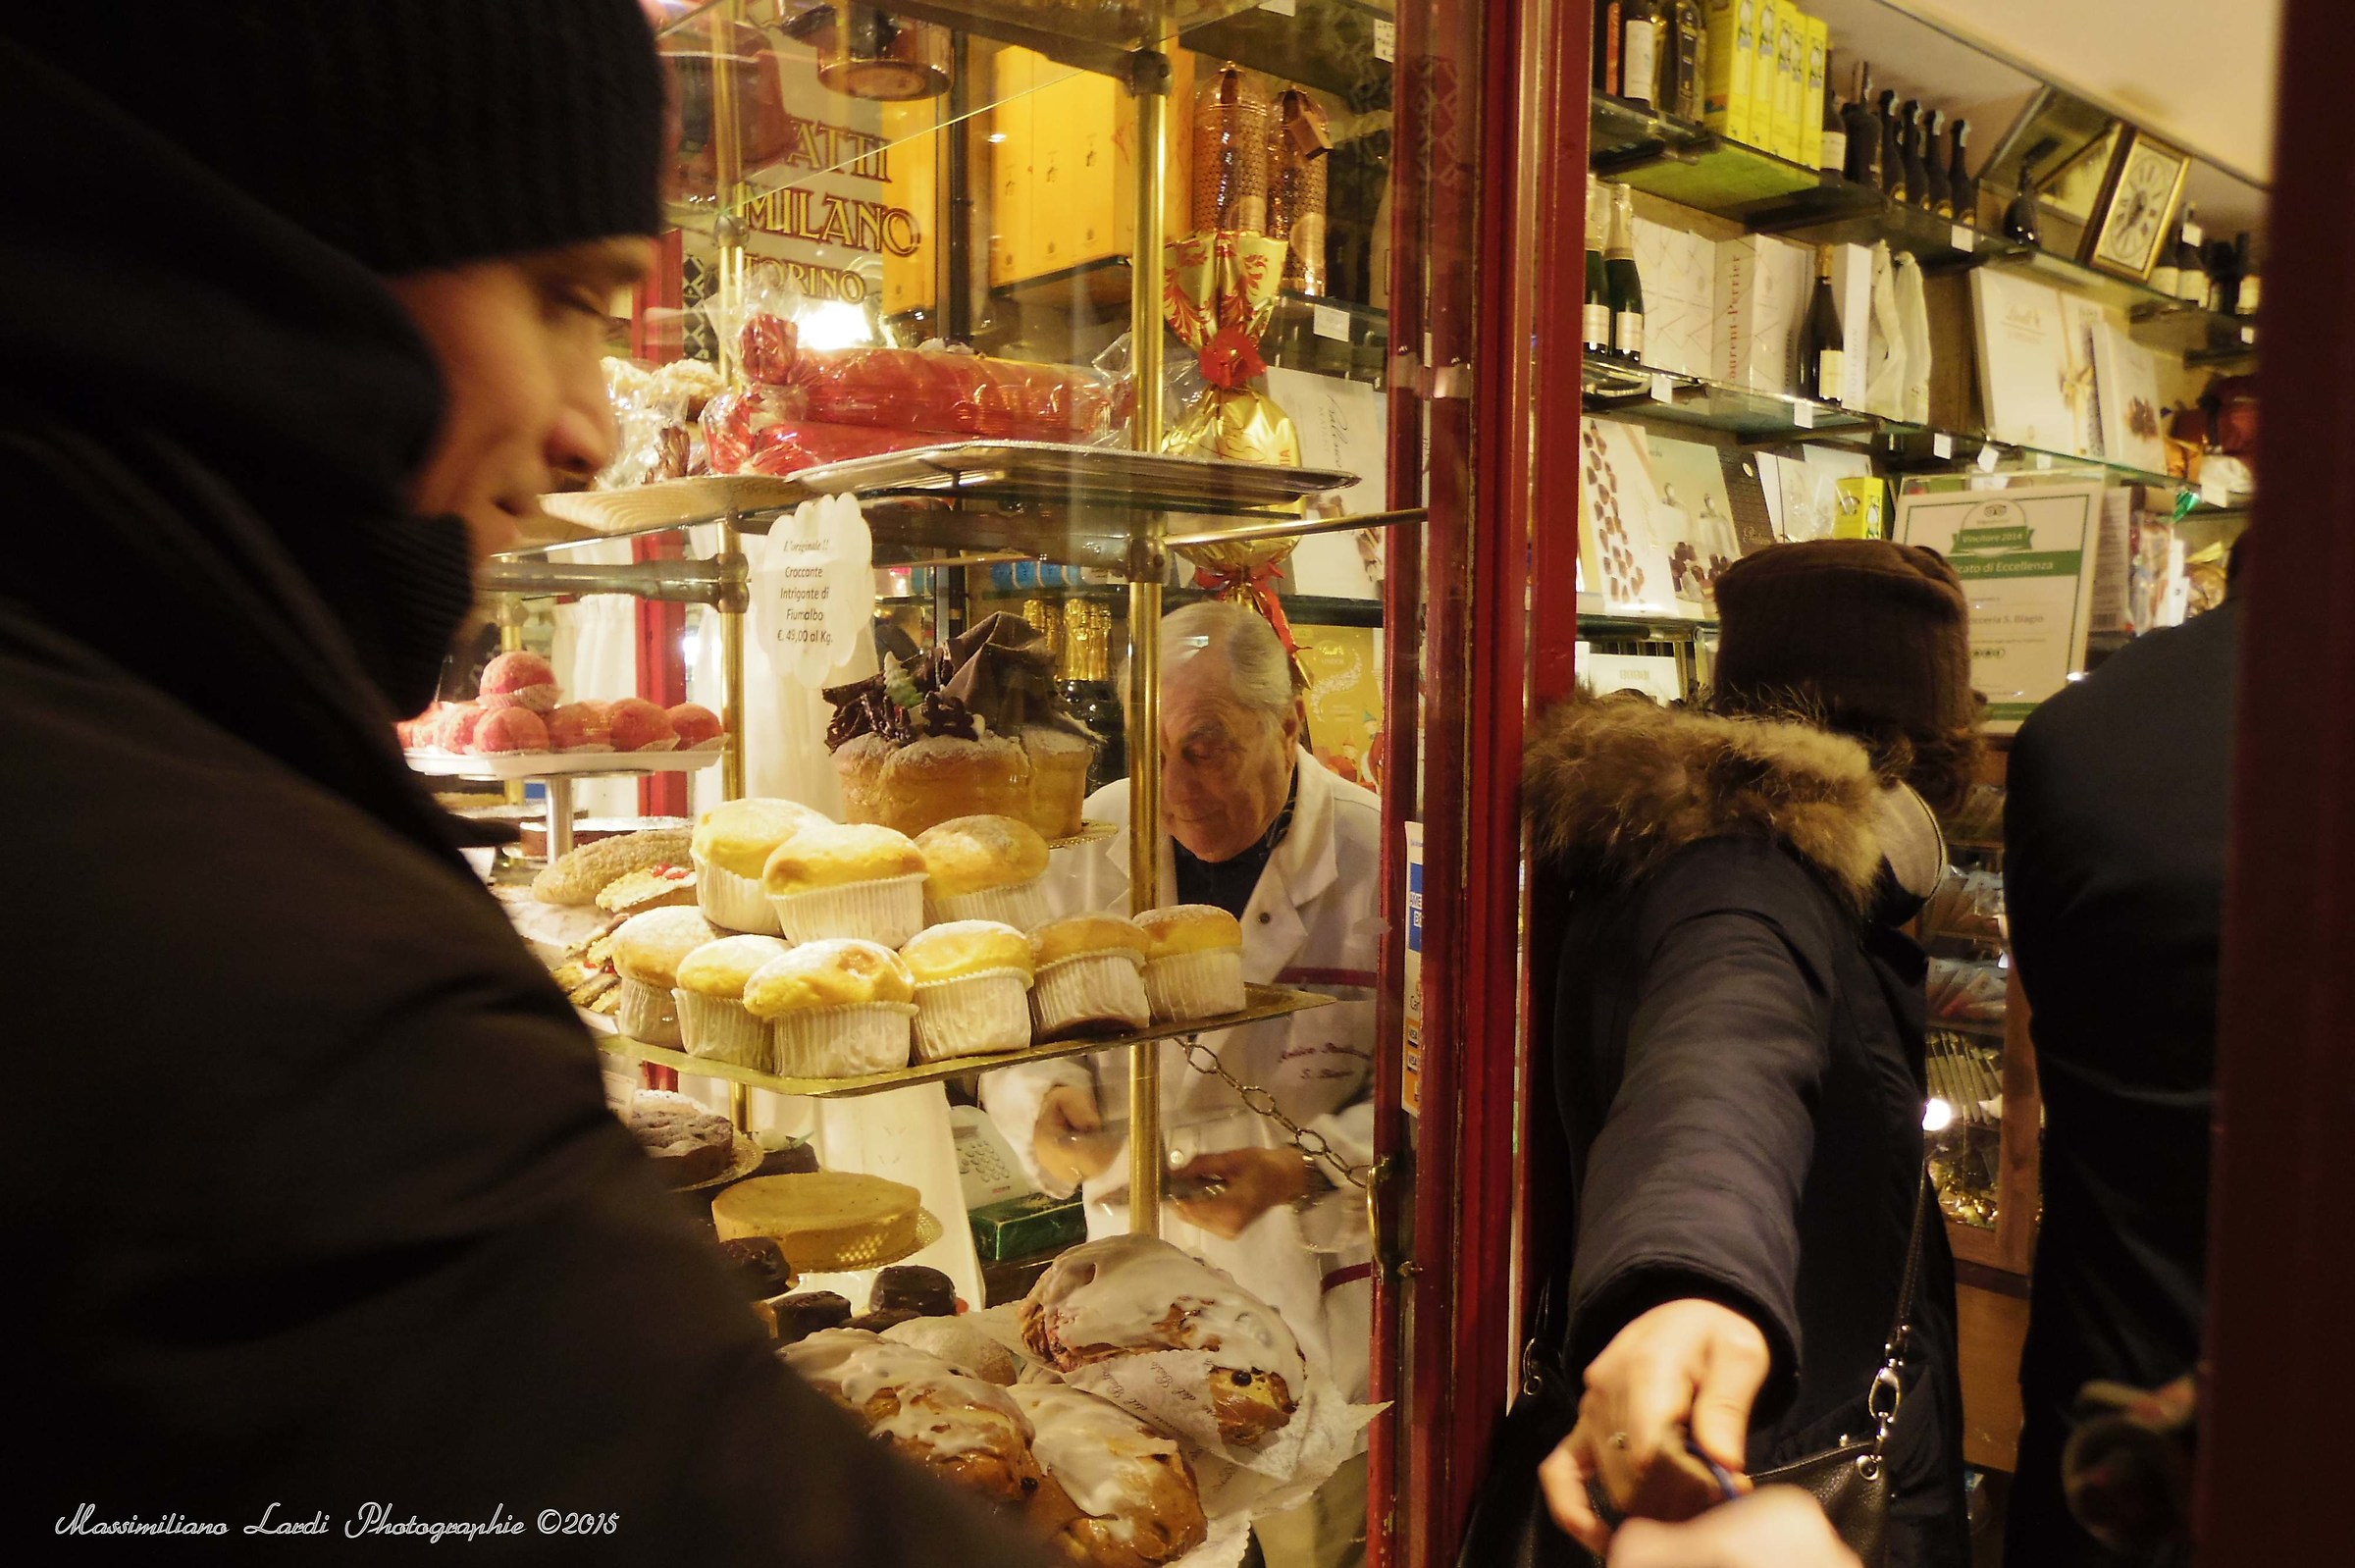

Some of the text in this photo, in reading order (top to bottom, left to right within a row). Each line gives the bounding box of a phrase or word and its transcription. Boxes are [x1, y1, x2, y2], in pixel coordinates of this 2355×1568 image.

[786, 115, 892, 183] ATTI
[730, 181, 922, 257] MILANO
[736, 251, 865, 305] TORINO
[785, 566, 823, 578] Croccante
[1982, 560, 1995, 573] di
[1996, 560, 2054, 573] Eccellenza
[780, 586, 829, 602] Intrigante di
[786, 607, 824, 621] Fiumalbo
[810, 629, 818, 643] al
[820, 630, 833, 646] Kg.
